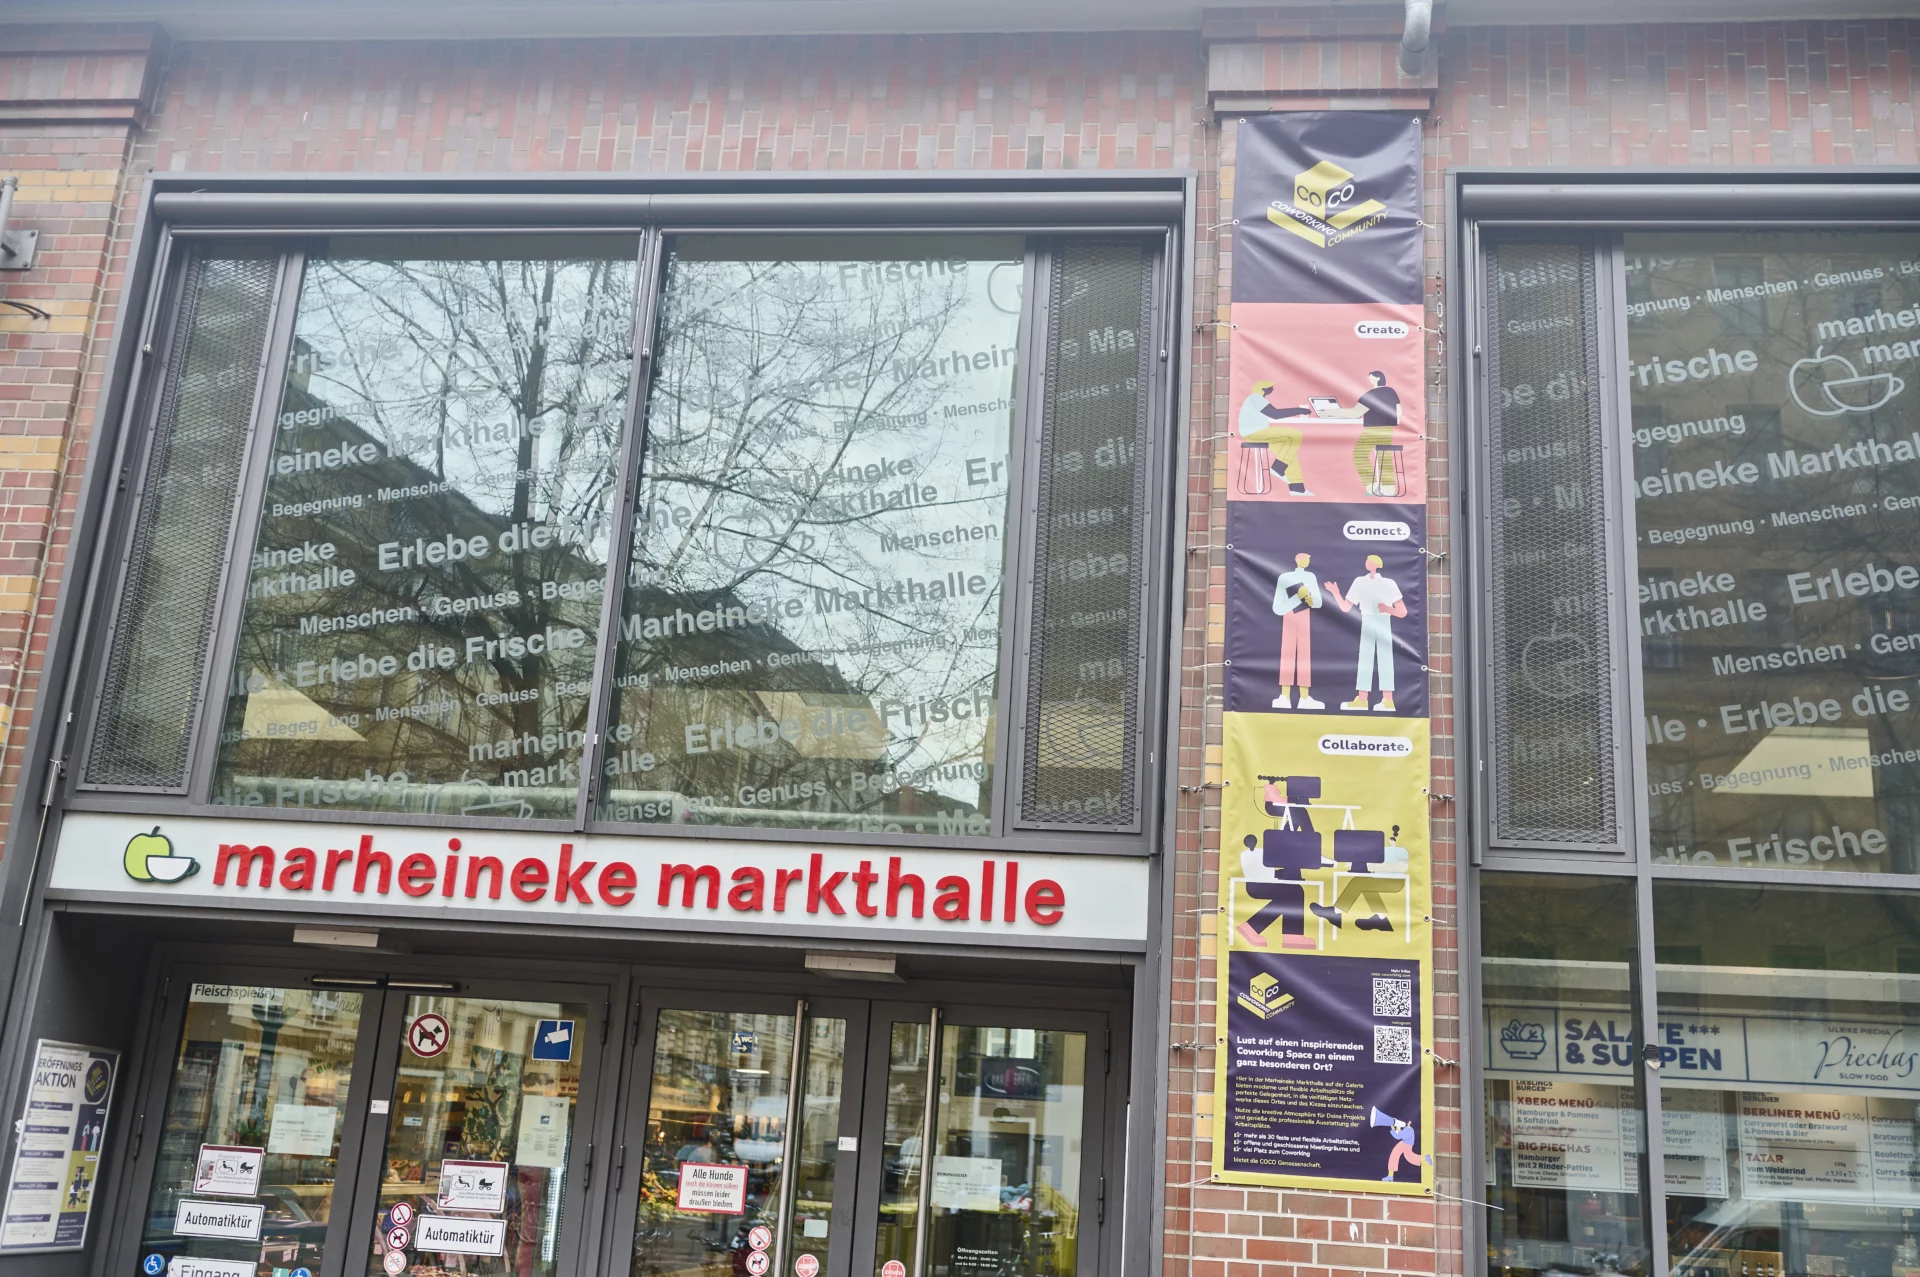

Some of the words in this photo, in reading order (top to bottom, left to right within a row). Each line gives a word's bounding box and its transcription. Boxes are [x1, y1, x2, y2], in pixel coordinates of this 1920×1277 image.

[1297, 185, 1322, 206] CO
[1327, 184, 1354, 208] CO
[1271, 201, 1337, 236] COWORKING
[1327, 211, 1389, 247] COMMUNITY
[839, 256, 967, 290] Frische
[1707, 279, 1798, 303] Menschen
[1815, 266, 1884, 287] Genuss
[1357, 323, 1405, 336] Create.
[387, 413, 547, 458] Markthalle
[751, 456, 914, 496] marheineke
[272, 493, 362, 518] Begegnung
[378, 479, 459, 502] Menschen
[787, 481, 938, 521] markthalle
[880, 521, 998, 552] Menschen
[1346, 525, 1407, 538] Connect.
[1649, 519, 1755, 544] Begegnung
[1772, 503, 1867, 527] Menschen
[378, 532, 489, 570] Erlebe
[499, 523, 552, 552] die
[1787, 563, 1920, 605] Erlebe
[300, 605, 413, 635] Menschen
[435, 588, 519, 618] Genuss
[619, 594, 804, 642] Marheineke
[814, 569, 987, 617] Markthalle
[296, 654, 397, 687] Erlebe
[407, 643, 456, 672] die
[466, 626, 586, 664] Frische
[1712, 643, 1847, 676] Menschen
[376, 699, 460, 722] Menschen
[476, 686, 538, 707] Genuss
[665, 658, 751, 680] Menschen
[767, 649, 831, 669] Genuss
[1720, 696, 1841, 734] Erlebe
[1852, 685, 1910, 716] die
[685, 715, 797, 757] Erlebe
[812, 707, 869, 738] die
[880, 690, 994, 729] Frisch
[1321, 738, 1410, 753] Collaborate.
[739, 780, 827, 807] Genuss
[851, 759, 989, 793] Begegnung
[1700, 763, 1811, 790] Begegnung
[1727, 825, 1887, 868] Frische
[211, 834, 638, 906] marheineke
[656, 853, 1066, 925] markthalle
[1237, 1036, 1256, 1044] Lust
[1275, 1039, 1298, 1047] einen
[1301, 1040, 1364, 1050] inspirierenden
[1237, 1047, 1283, 1058] Coworking
[1286, 1050, 1312, 1060] Space
[1328, 1052, 1354, 1061] einem
[1566, 1043, 1586, 1064] &
[1592, 1044, 1722, 1070] SUPEN
[1260, 1060, 1310, 1070] besonderen
[1313, 1063, 1333, 1071] Ort?
[35, 1072, 76, 1088] AKTION
[1517, 1097, 1556, 1106] XBERG
[1559, 1098, 1594, 1108] MENÜ
[1517, 1109, 1558, 1117] Hamburger
[1743, 1107, 1802, 1118] BERLINER
[1805, 1110, 1840, 1120] MENÜ
[1744, 1120, 1787, 1129] Currywurst
[1808, 1123, 1848, 1131] Bratwurst
[1751, 1128, 1784, 1136] Pommes
[1874, 1133, 1913, 1141] Bratwurst
[1517, 1141, 1538, 1151] BIG
[1540, 1143, 1591, 1153] PIECHAS
[1518, 1153, 1561, 1162] Hamburger
[1746, 1152, 1784, 1163] TATAR
[693, 1169, 707, 1179] Alle
[709, 1170, 733, 1180] Hunde
[1538, 1163, 1593, 1172] Rinder-Patties
[713, 1199, 732, 1208] bleiben
[715, 1190, 731, 1198] leider
[185, 1211, 252, 1229] Automatiktür
[425, 1226, 495, 1244] Automatiktür
